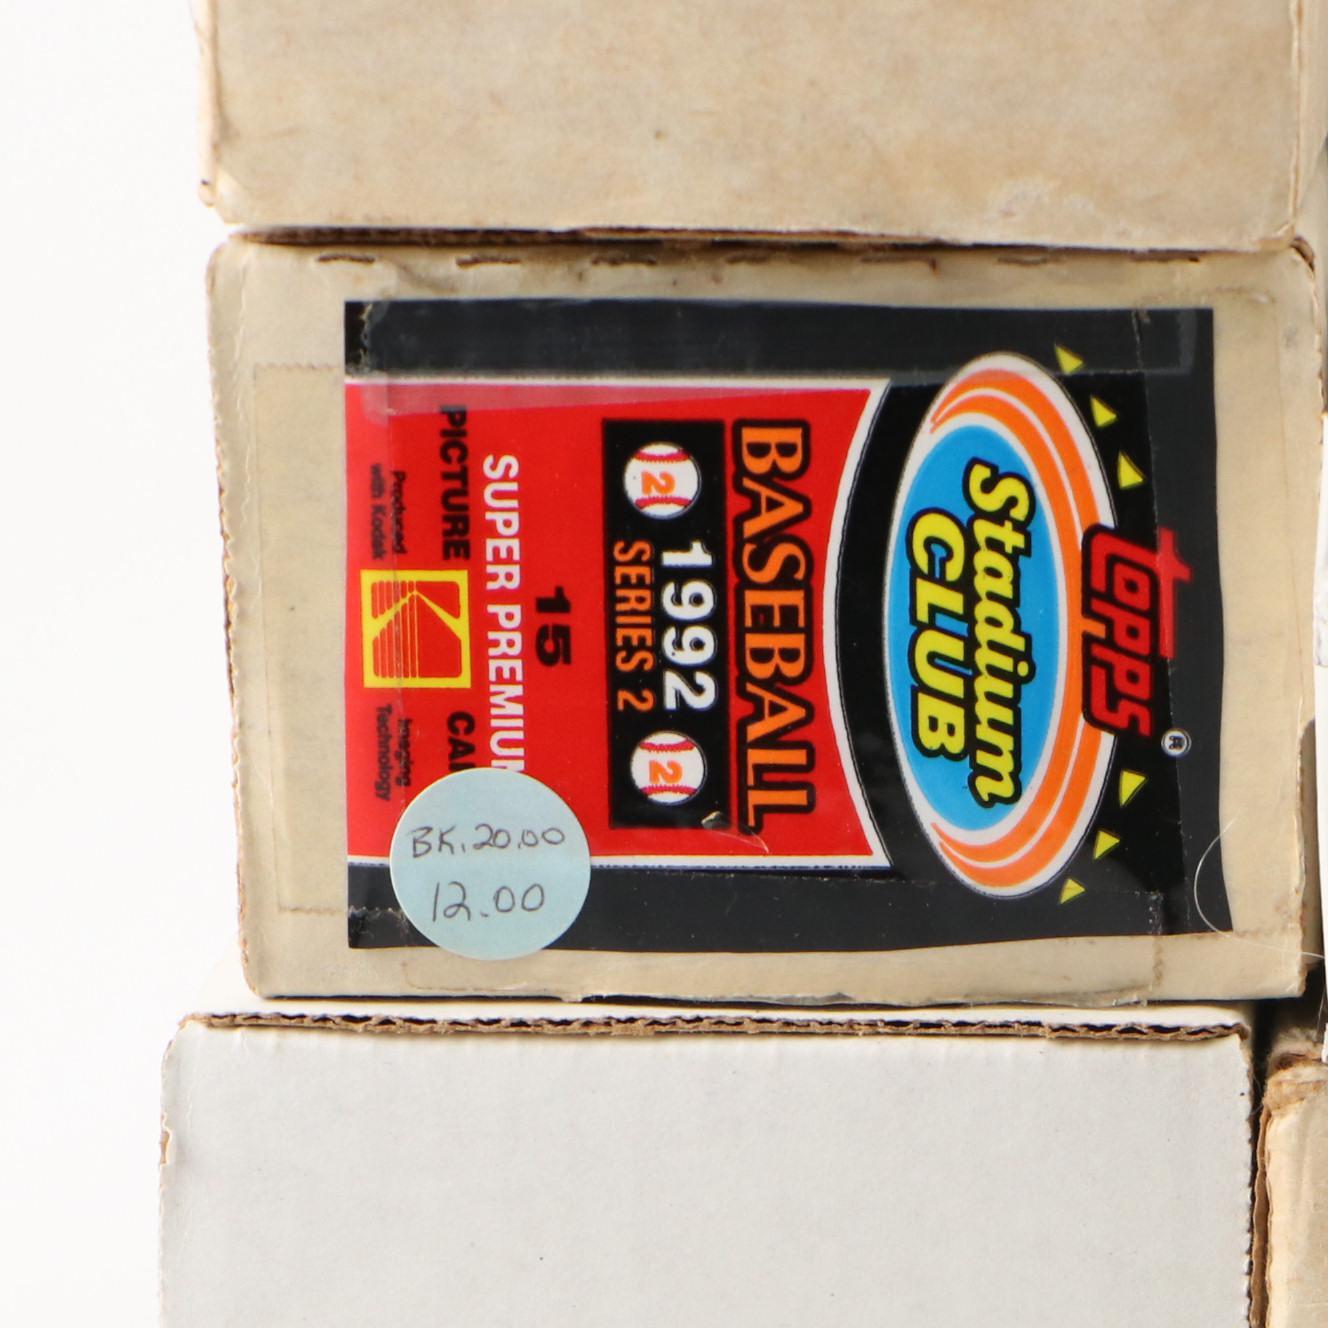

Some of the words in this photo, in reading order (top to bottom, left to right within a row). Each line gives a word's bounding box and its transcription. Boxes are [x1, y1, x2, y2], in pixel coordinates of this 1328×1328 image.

[371, 505, 386, 560] Kodak
[439, 405, 470, 560] PICTURE
[483, 454, 521, 591] SUPER
[641, 470, 676, 495] 2
[535, 586, 573, 667] 15
[613, 540, 654, 675] SERIES
[661, 540, 718, 713] 1992
[738, 424, 812, 828] BASEBALL
[910, 514, 967, 757] CLUB
[966, 462, 1033, 805] Stadium
[1088, 524, 1193, 738] Topps
[374, 703, 393, 801] Technology
[617, 688, 655, 713] 2
[649, 760, 683, 785] 2
[432, 881, 546, 922] 12.00
